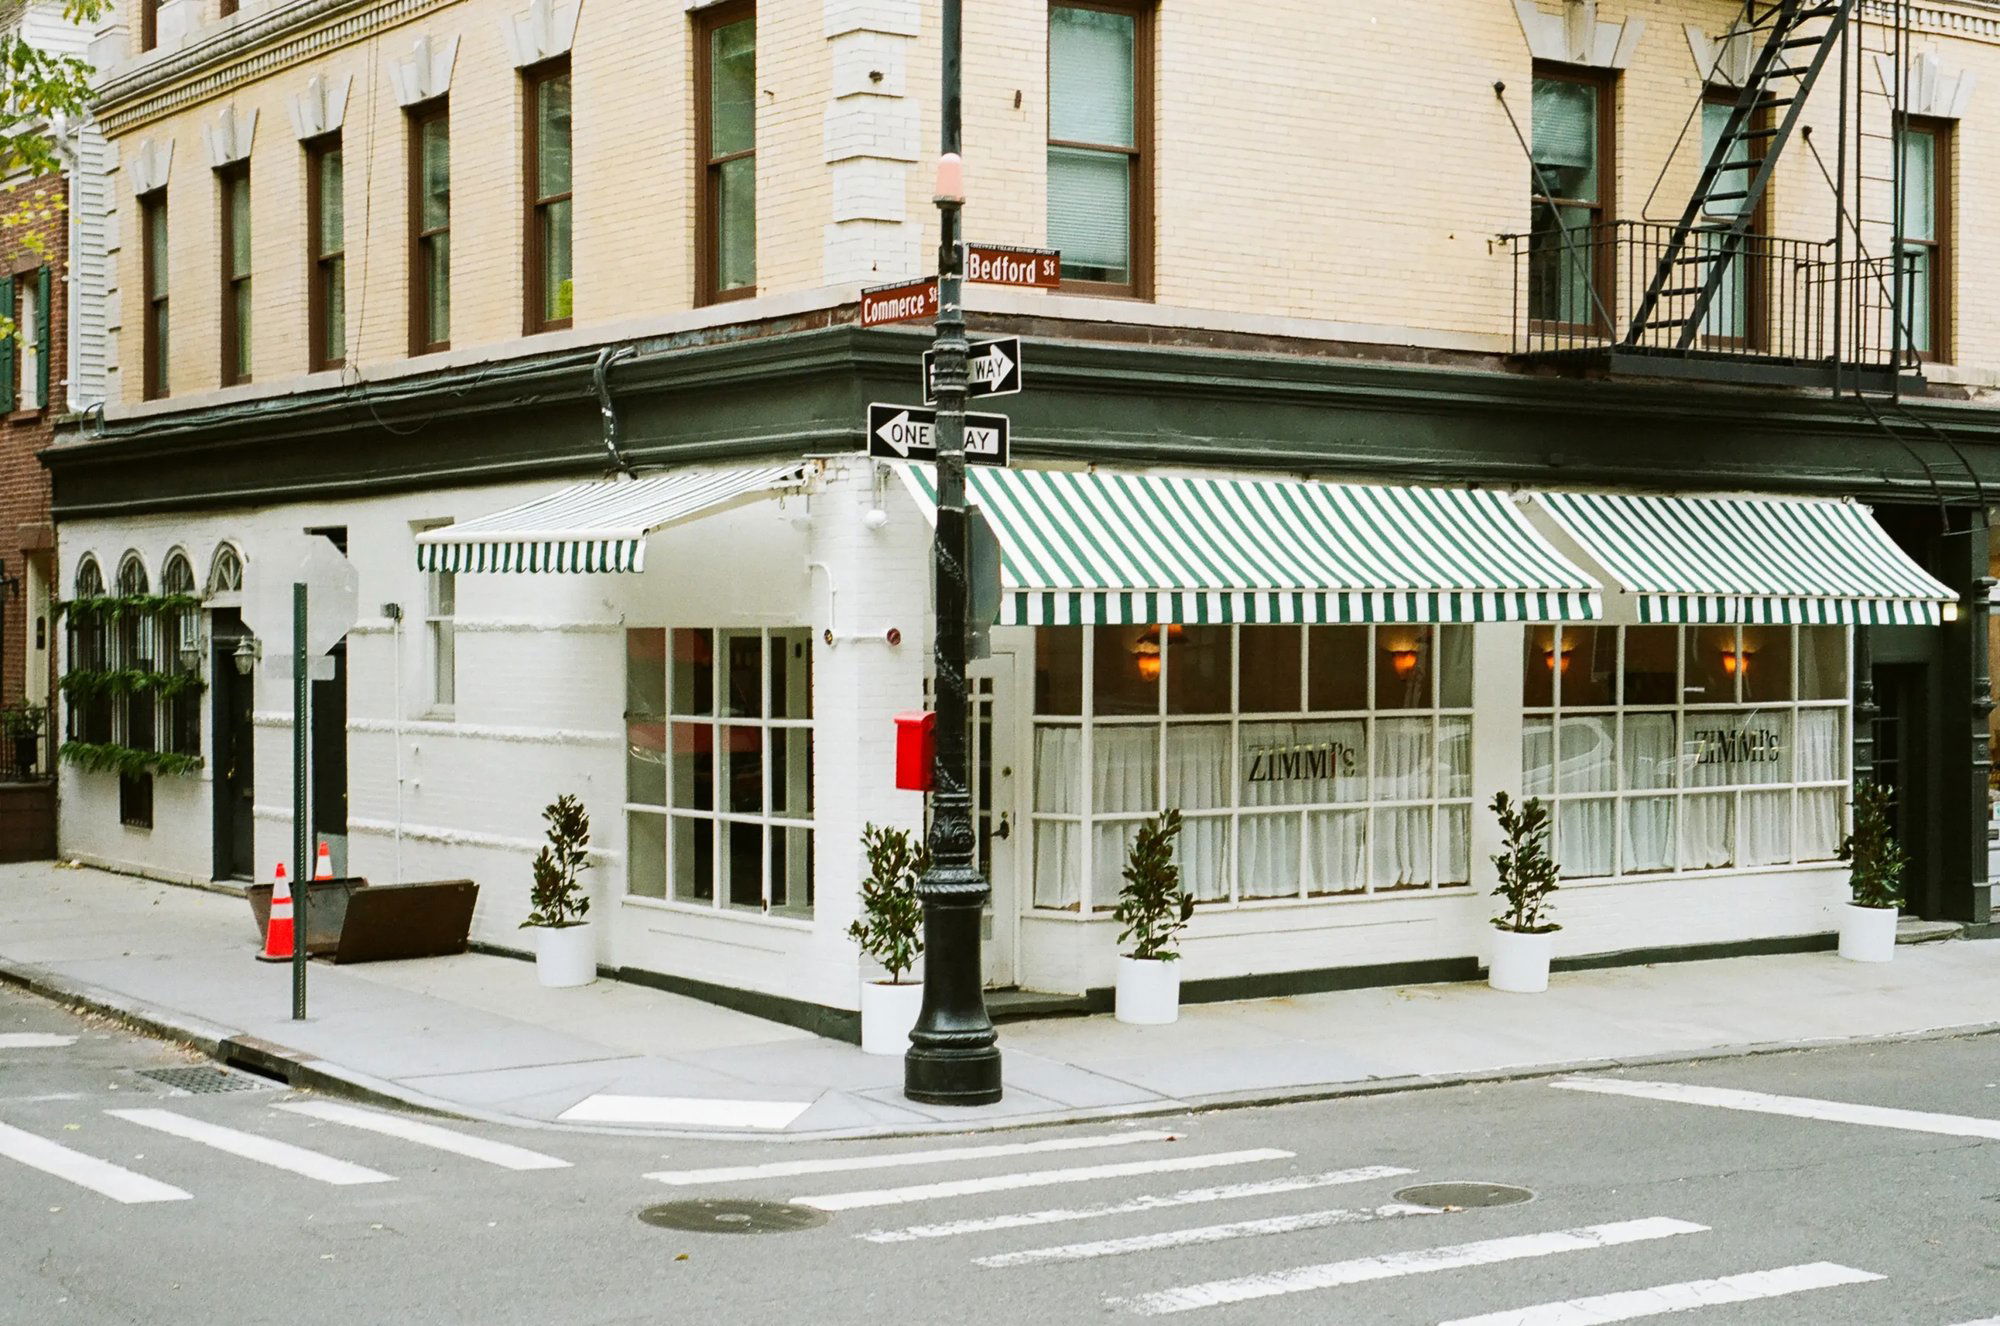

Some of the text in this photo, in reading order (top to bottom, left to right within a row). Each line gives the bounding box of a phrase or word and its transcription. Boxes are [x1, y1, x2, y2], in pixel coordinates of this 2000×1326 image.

[969, 253, 1056, 284] Bedford St
[864, 294, 925, 323] Commerce
[928, 286, 938, 303] St
[975, 357, 1004, 380] WAY
[891, 423, 990, 450] ONE AY
[1248, 742, 1356, 782] ZIMMI's
[1694, 729, 1779, 764] ZIMMI's
